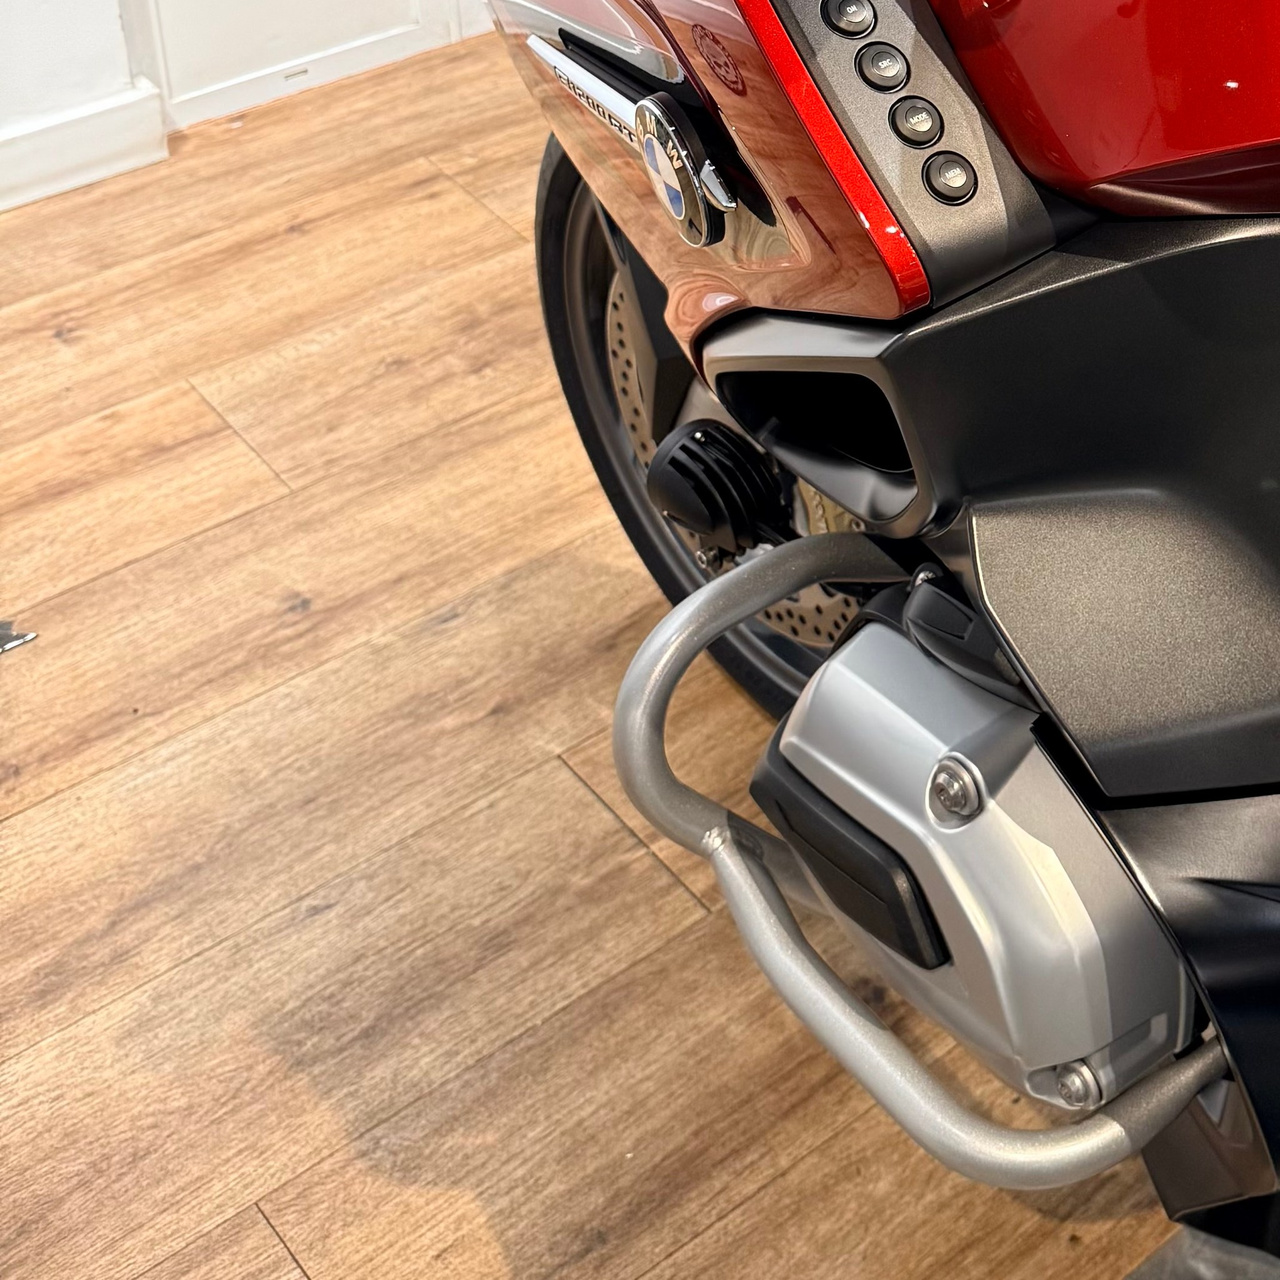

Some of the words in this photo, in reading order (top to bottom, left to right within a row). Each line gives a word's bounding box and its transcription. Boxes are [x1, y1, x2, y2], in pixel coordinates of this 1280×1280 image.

[846, 4, 857, 14] ON
[878, 58, 892, 69] SRC
[909, 111, 929, 125] MODE
[945, 167, 961, 179] MEM
